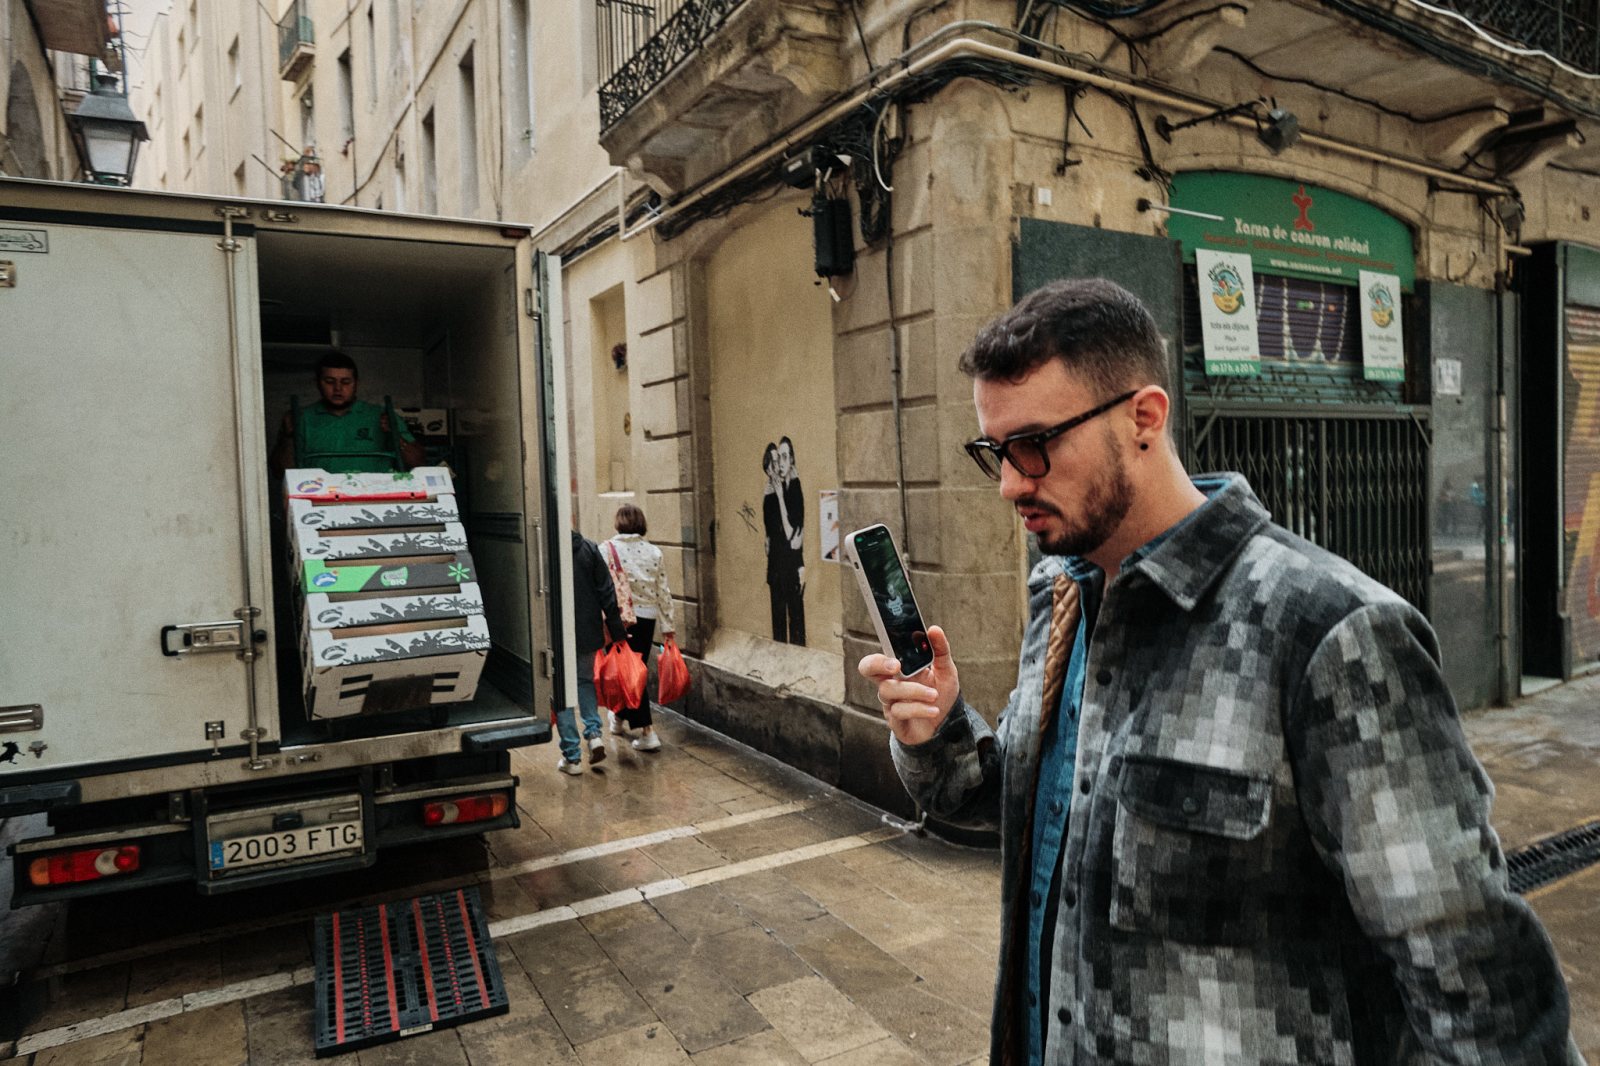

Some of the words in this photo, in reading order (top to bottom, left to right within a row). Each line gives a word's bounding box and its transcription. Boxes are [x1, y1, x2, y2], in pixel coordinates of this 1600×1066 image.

[1234, 217, 1271, 238] Xarxa
[1272, 225, 1288, 241] de
[1290, 231, 1331, 249] consum
[1333, 236, 1370, 257] solidari
[227, 833, 297, 864] 2003
[307, 824, 357, 850] FTG
